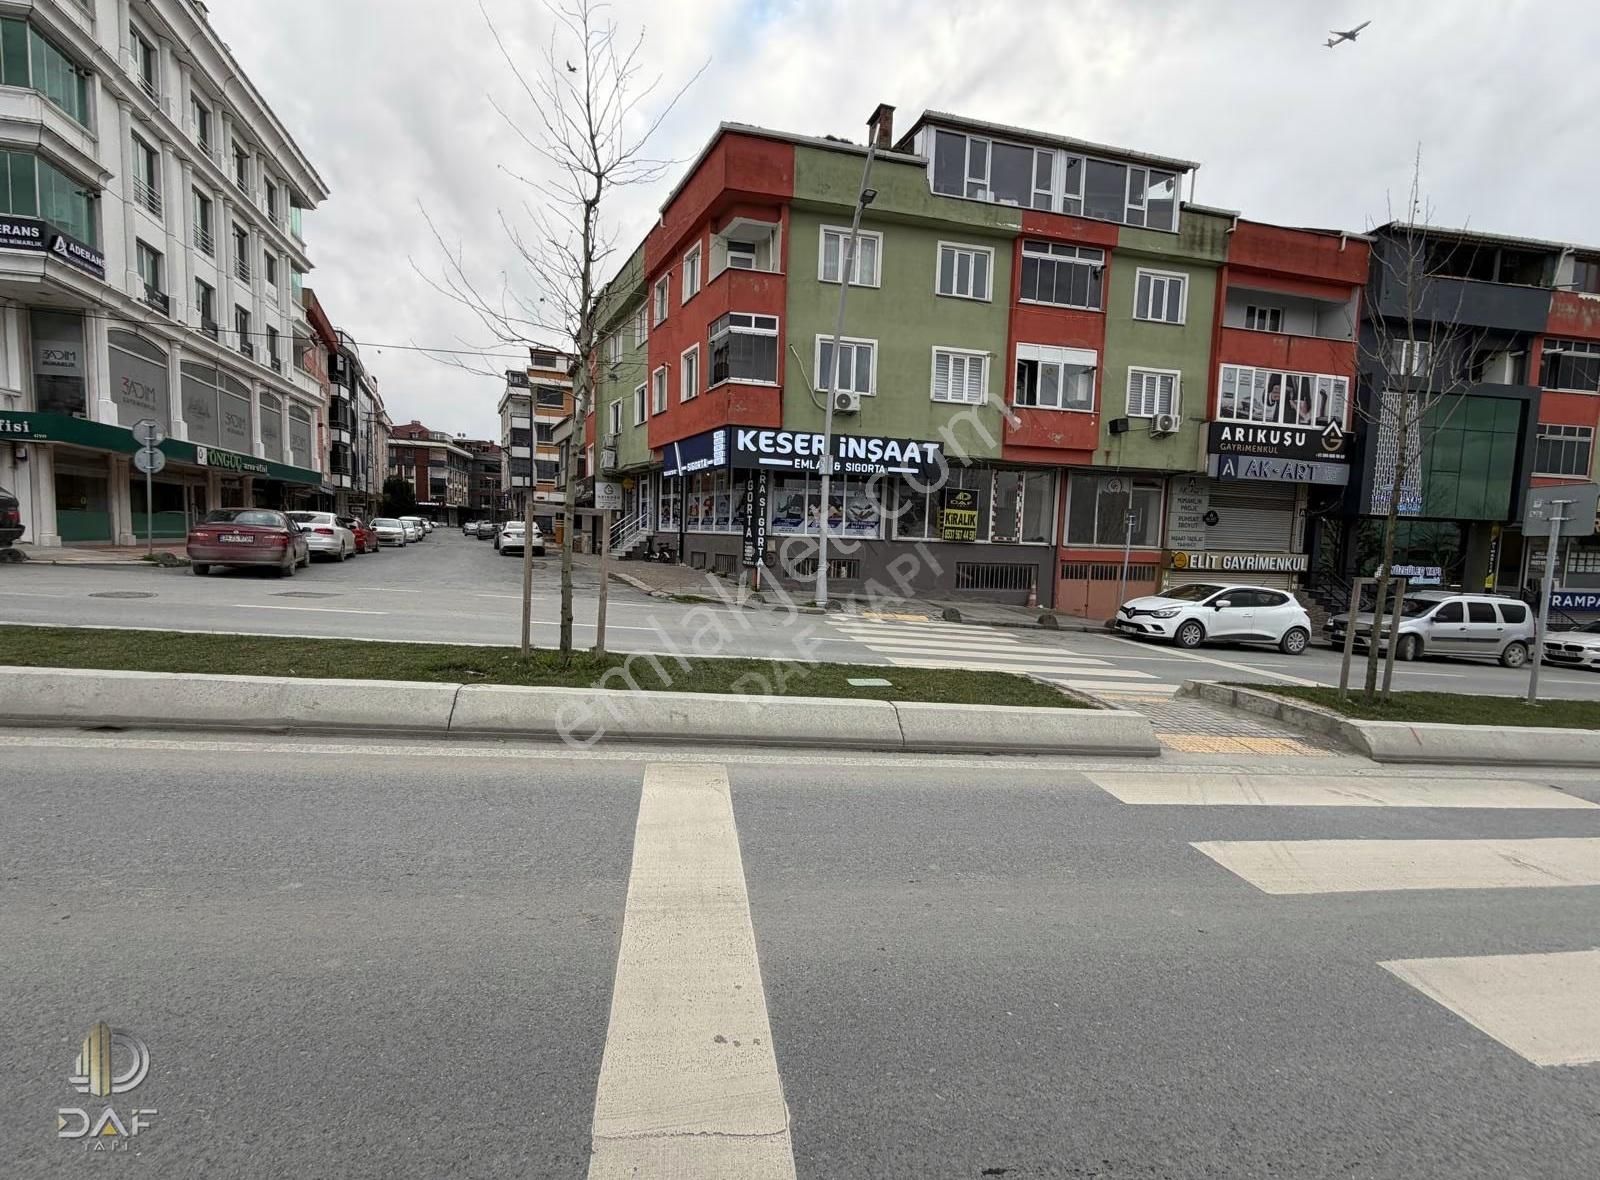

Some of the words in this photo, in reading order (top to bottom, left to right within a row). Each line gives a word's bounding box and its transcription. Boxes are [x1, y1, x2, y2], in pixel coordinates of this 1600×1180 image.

[0, 223, 40, 238] RANS
[737, 429, 826, 456] KESER
[1221, 426, 1306, 447] ARIKUŞU
[834, 463, 841, 471] &
[1190, 553, 1218, 569] ELİT
